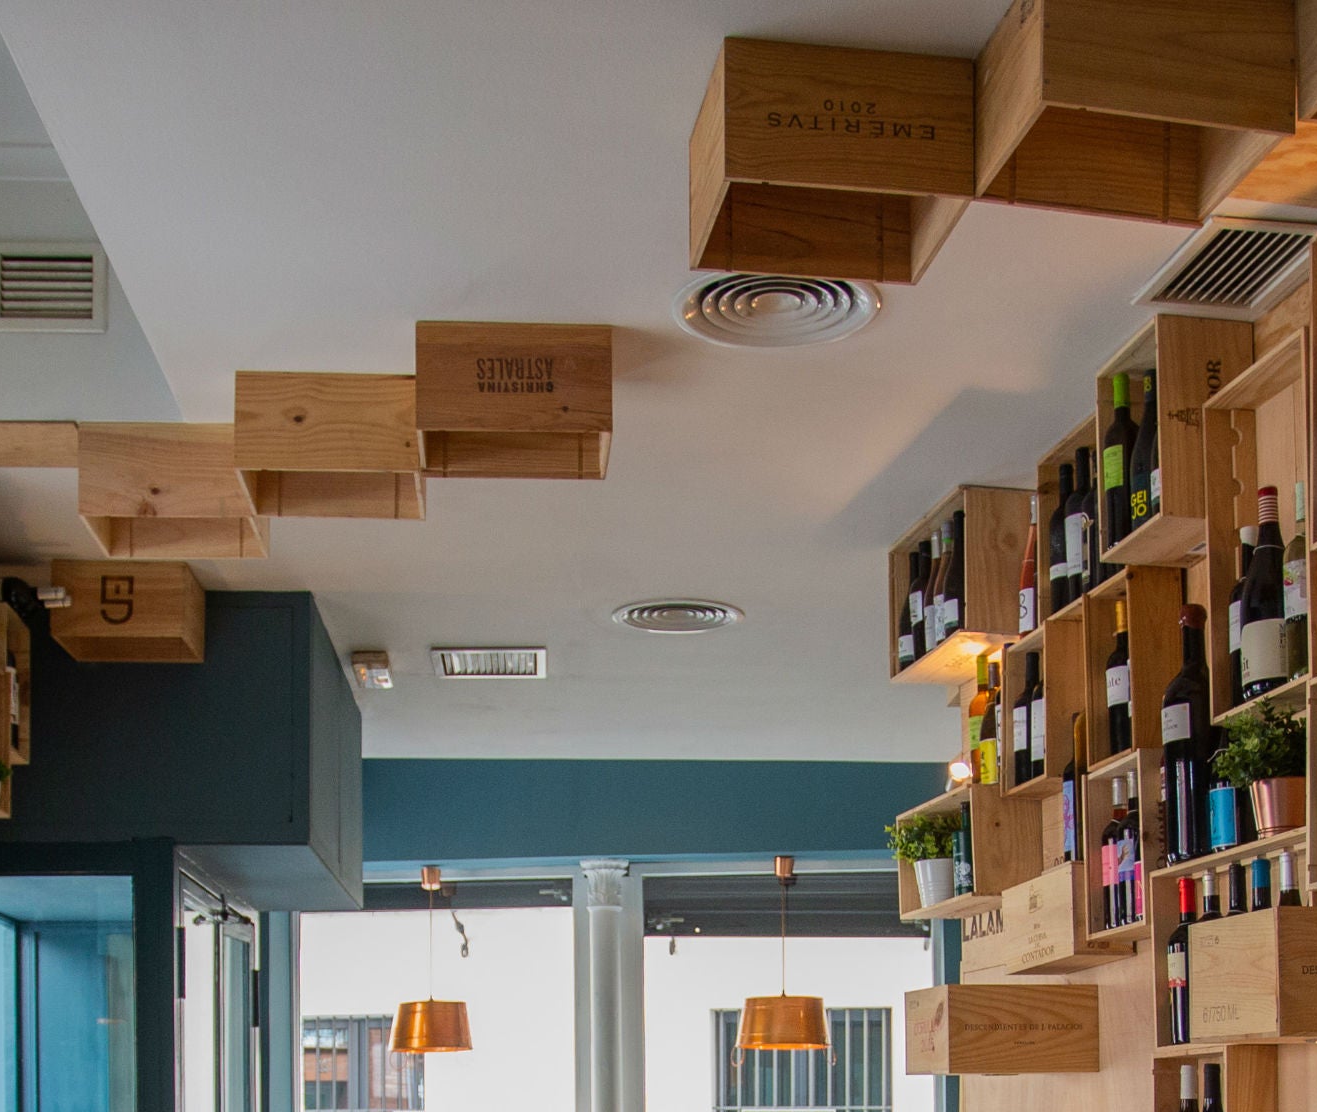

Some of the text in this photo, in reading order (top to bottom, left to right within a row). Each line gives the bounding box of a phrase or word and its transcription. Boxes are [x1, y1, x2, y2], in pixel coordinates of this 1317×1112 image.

[823, 98, 877, 115] 2010
[476, 357, 554, 380] ASTRALES
[477, 380, 554, 393] CHRISTINA
[1021, 944, 1055, 964] CONTADOR
[963, 1022, 1027, 1032] DESCENDIENTES
[1028, 1023, 1040, 1032] DE
[1047, 1023, 1083, 1032] PALACIOS
